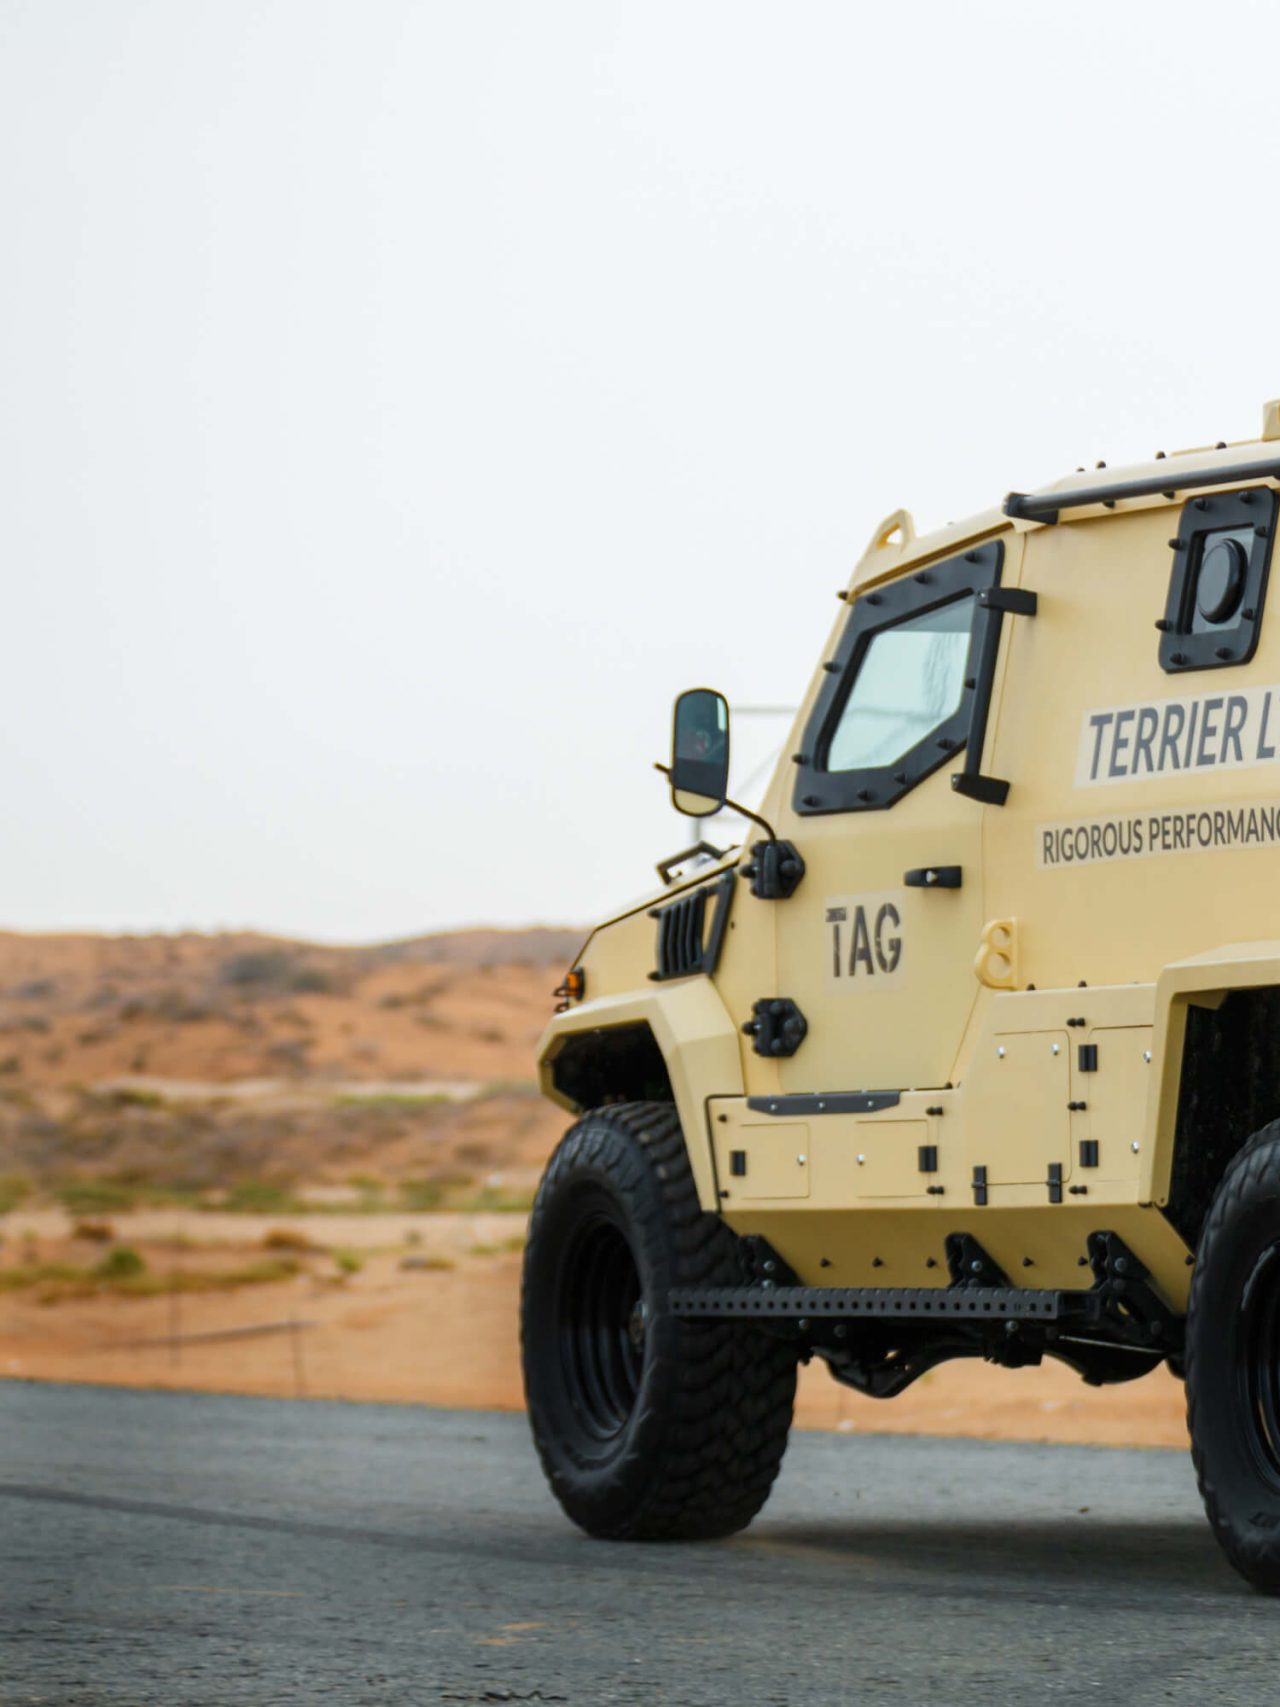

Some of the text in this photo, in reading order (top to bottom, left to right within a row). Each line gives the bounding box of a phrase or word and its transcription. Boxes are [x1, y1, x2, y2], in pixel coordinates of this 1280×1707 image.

[1089, 695, 1248, 781] TERRIER
[1042, 819, 1143, 864] RIGOROUS
[826, 902, 902, 978] TAG
